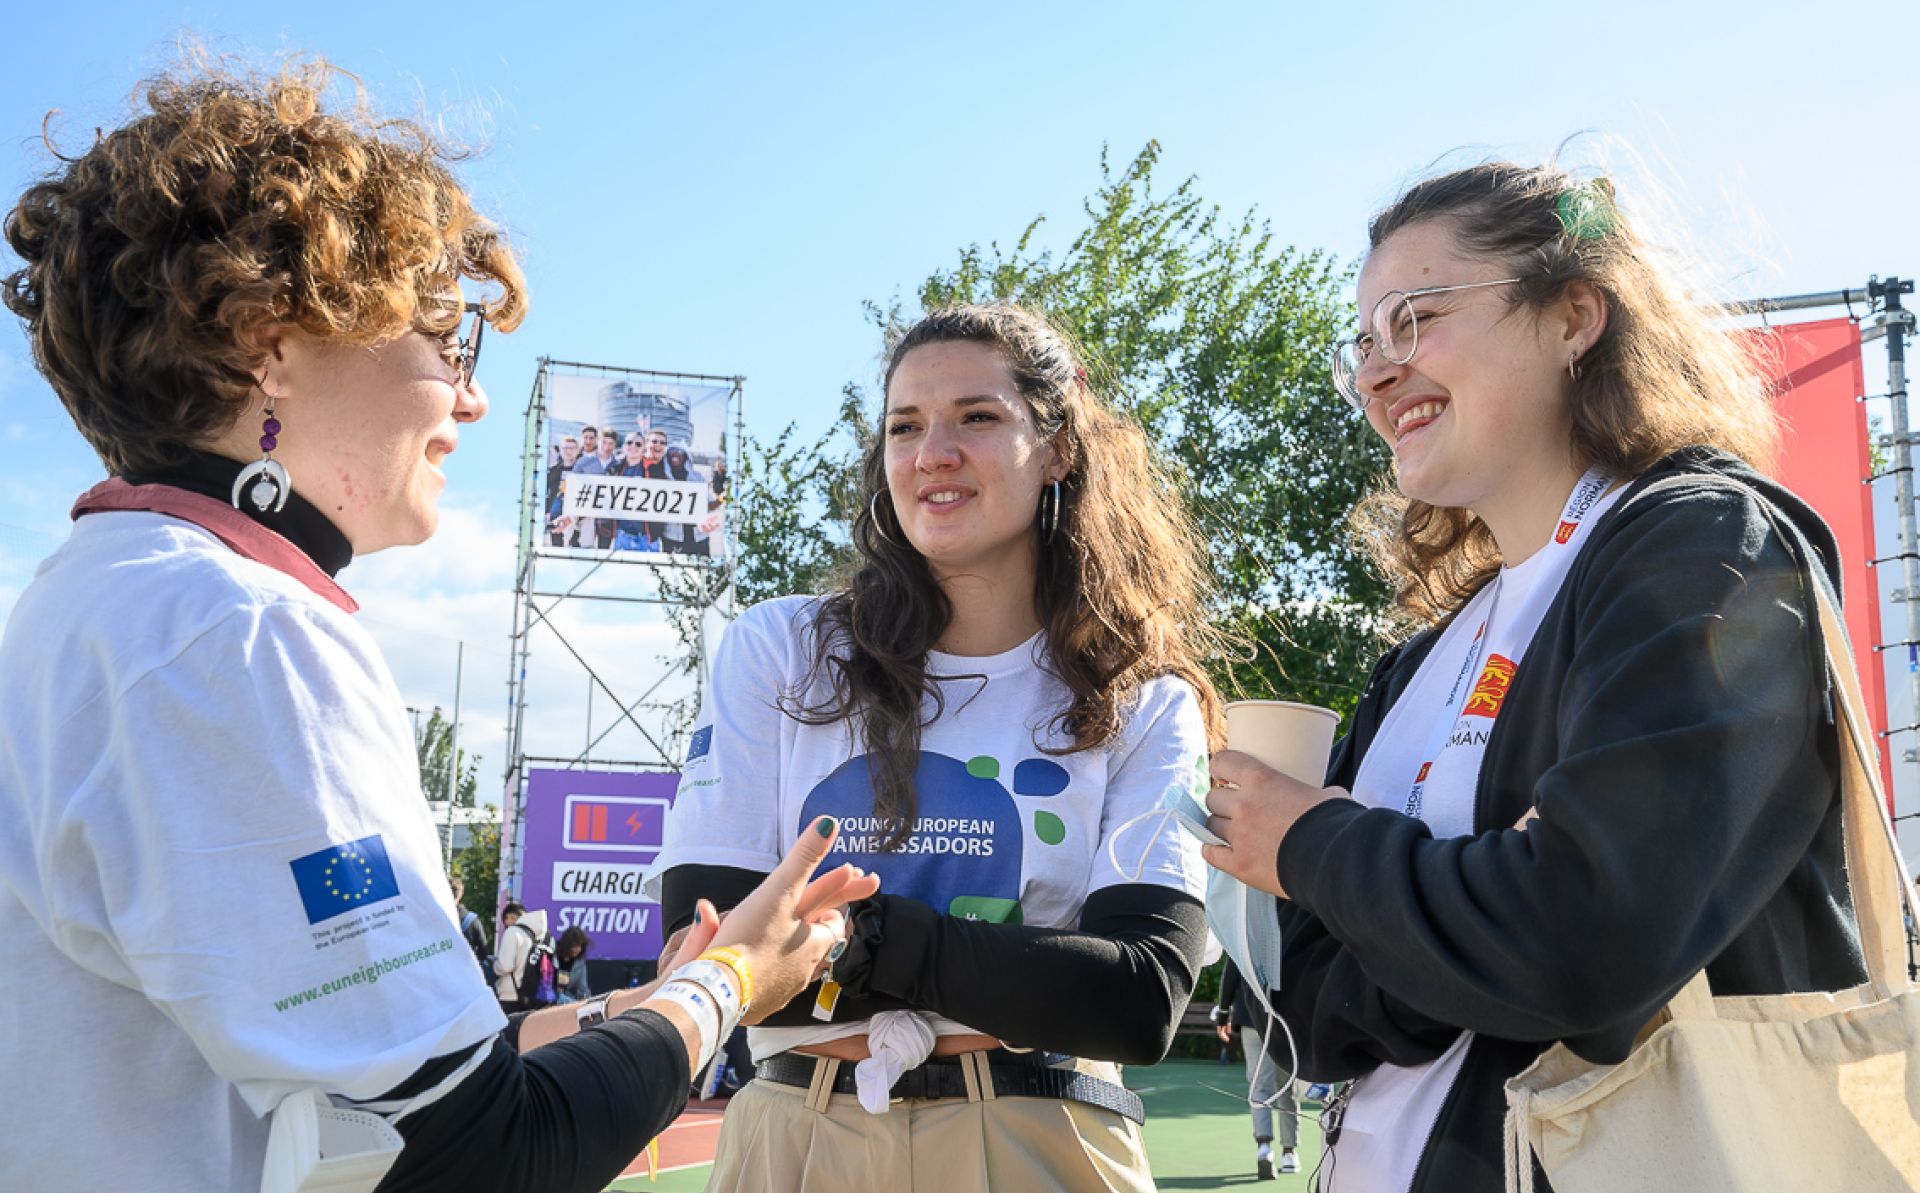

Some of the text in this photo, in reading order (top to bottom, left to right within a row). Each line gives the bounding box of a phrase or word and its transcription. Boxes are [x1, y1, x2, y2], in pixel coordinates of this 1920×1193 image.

[575, 484, 699, 516] #EYE2021
[900, 817, 995, 835] UROPEAN
[561, 870, 646, 895] CHARGI
[312, 929, 331, 940] This
[333, 916, 363, 933] project
[557, 906, 649, 934] STATION
[274, 938, 453, 1012] www.euneighbourseast.eu
